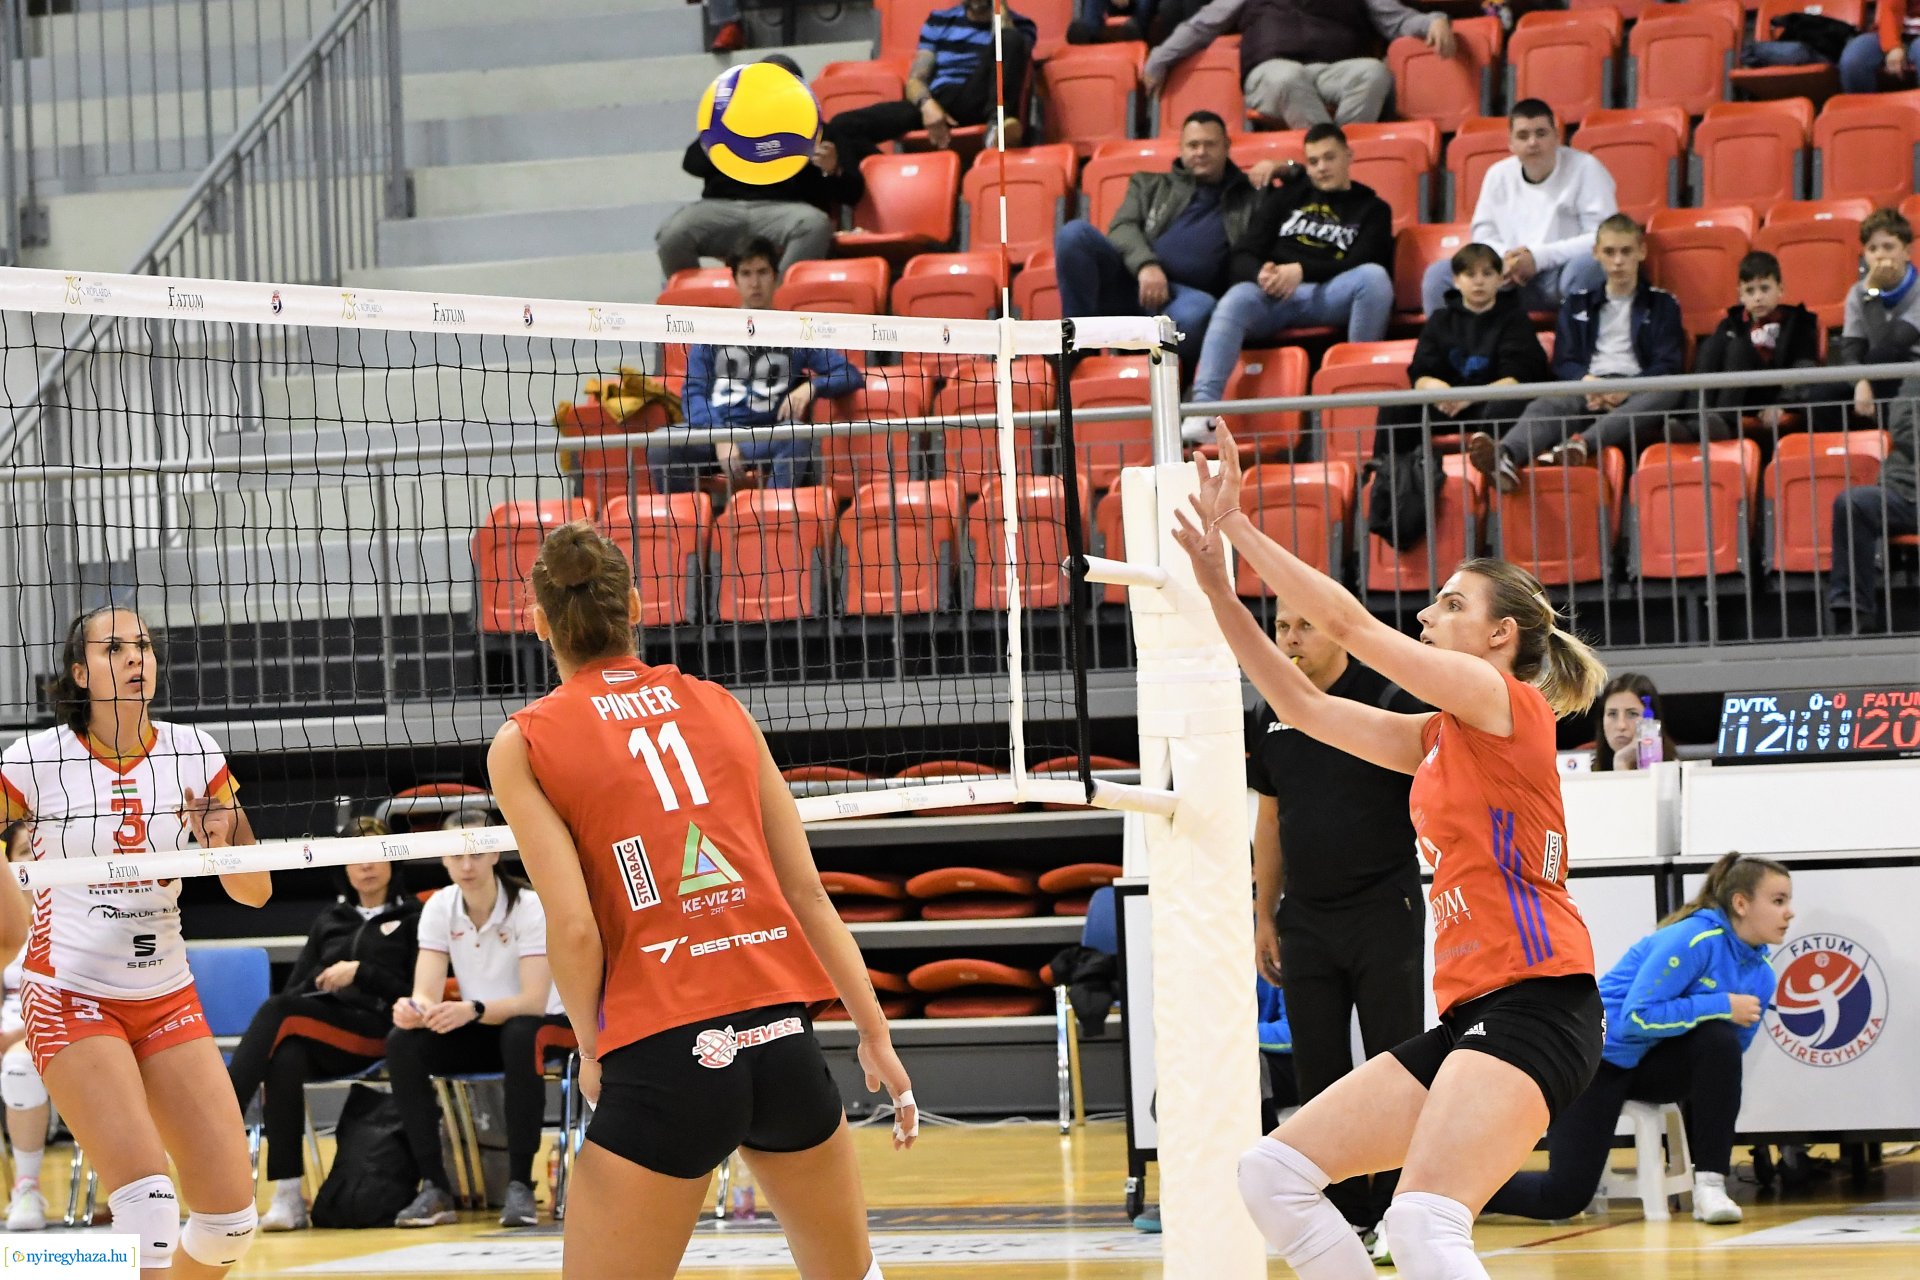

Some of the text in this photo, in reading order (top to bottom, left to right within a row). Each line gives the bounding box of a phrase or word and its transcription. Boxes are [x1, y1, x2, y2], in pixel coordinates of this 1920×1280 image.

[167, 286, 204, 308] FATUM
[432, 302, 466, 322] FATUM
[665, 314, 695, 333] FATUM
[871, 323, 898, 342] FATUM
[590, 685, 681, 721] PINTÉR
[1725, 697, 1777, 713] DVTK
[627, 720, 710, 812] 11
[111, 798, 146, 847] 3
[381, 841, 409, 857] FATUM
[1547, 835, 1558, 880] RABAG
[107, 861, 140, 879] FATUM
[622, 842, 652, 905] STRABAG
[682, 886, 747, 914] KE-VIZ 21
[689, 926, 789, 957] BESTRONG
[1790, 937, 1854, 957] FATUM
[126, 958, 164, 969] SEAT
[72, 997, 104, 1021] 3
